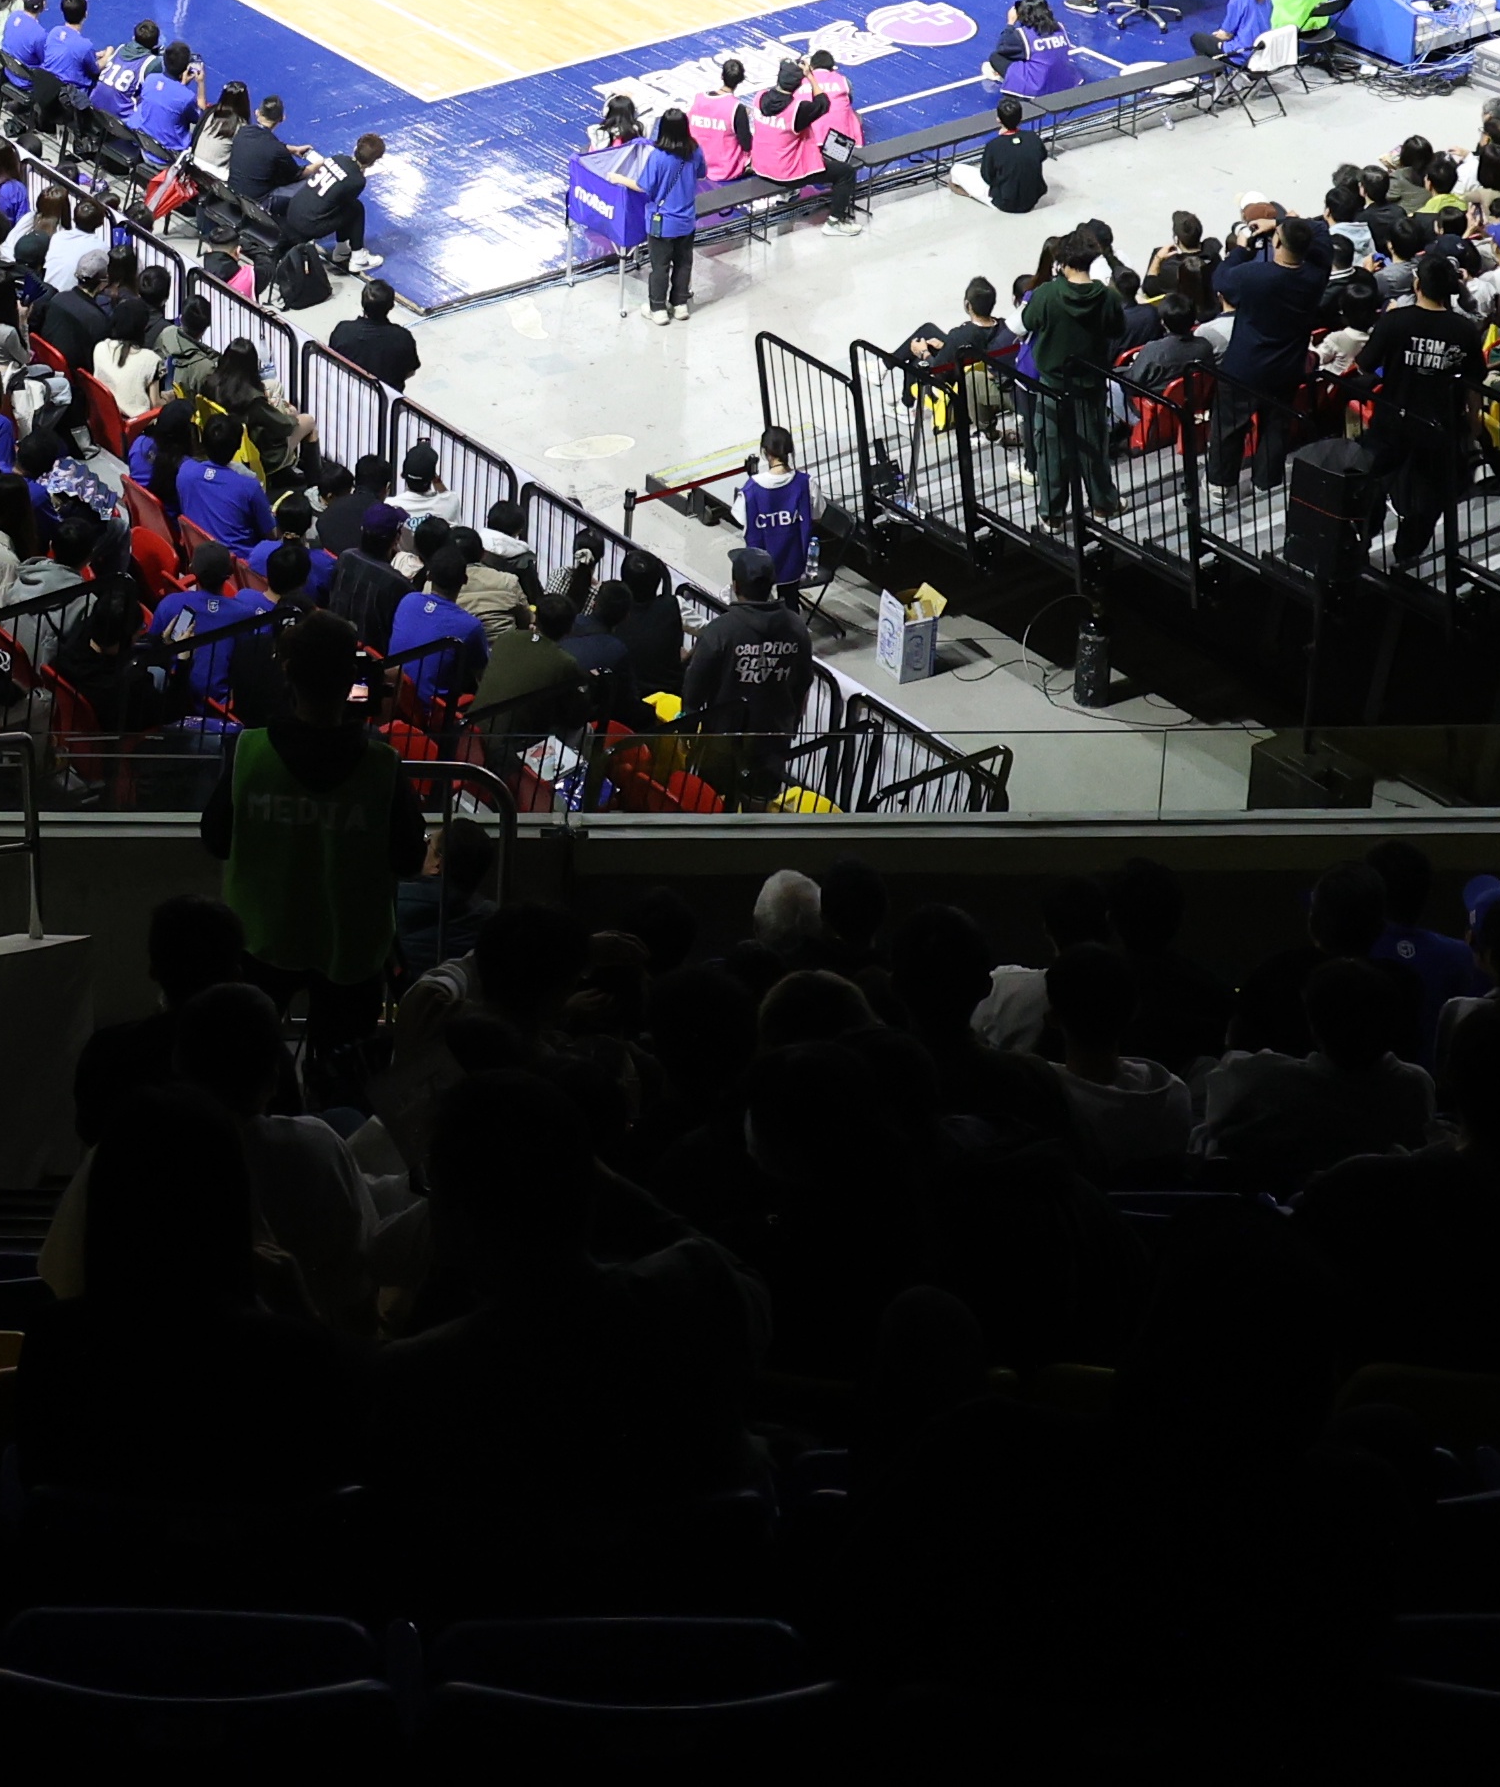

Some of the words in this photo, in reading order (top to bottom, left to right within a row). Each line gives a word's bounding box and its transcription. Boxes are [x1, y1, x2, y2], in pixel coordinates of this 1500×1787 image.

[1034, 35, 1067, 53] CTBA
[690, 114, 727, 131] MEDIA
[307, 166, 338, 198] 34
[574, 184, 615, 221] molten
[1410, 336, 1446, 355] TEAM
[755, 510, 804, 530] CTBA
[246, 793, 370, 835] MEDIA
